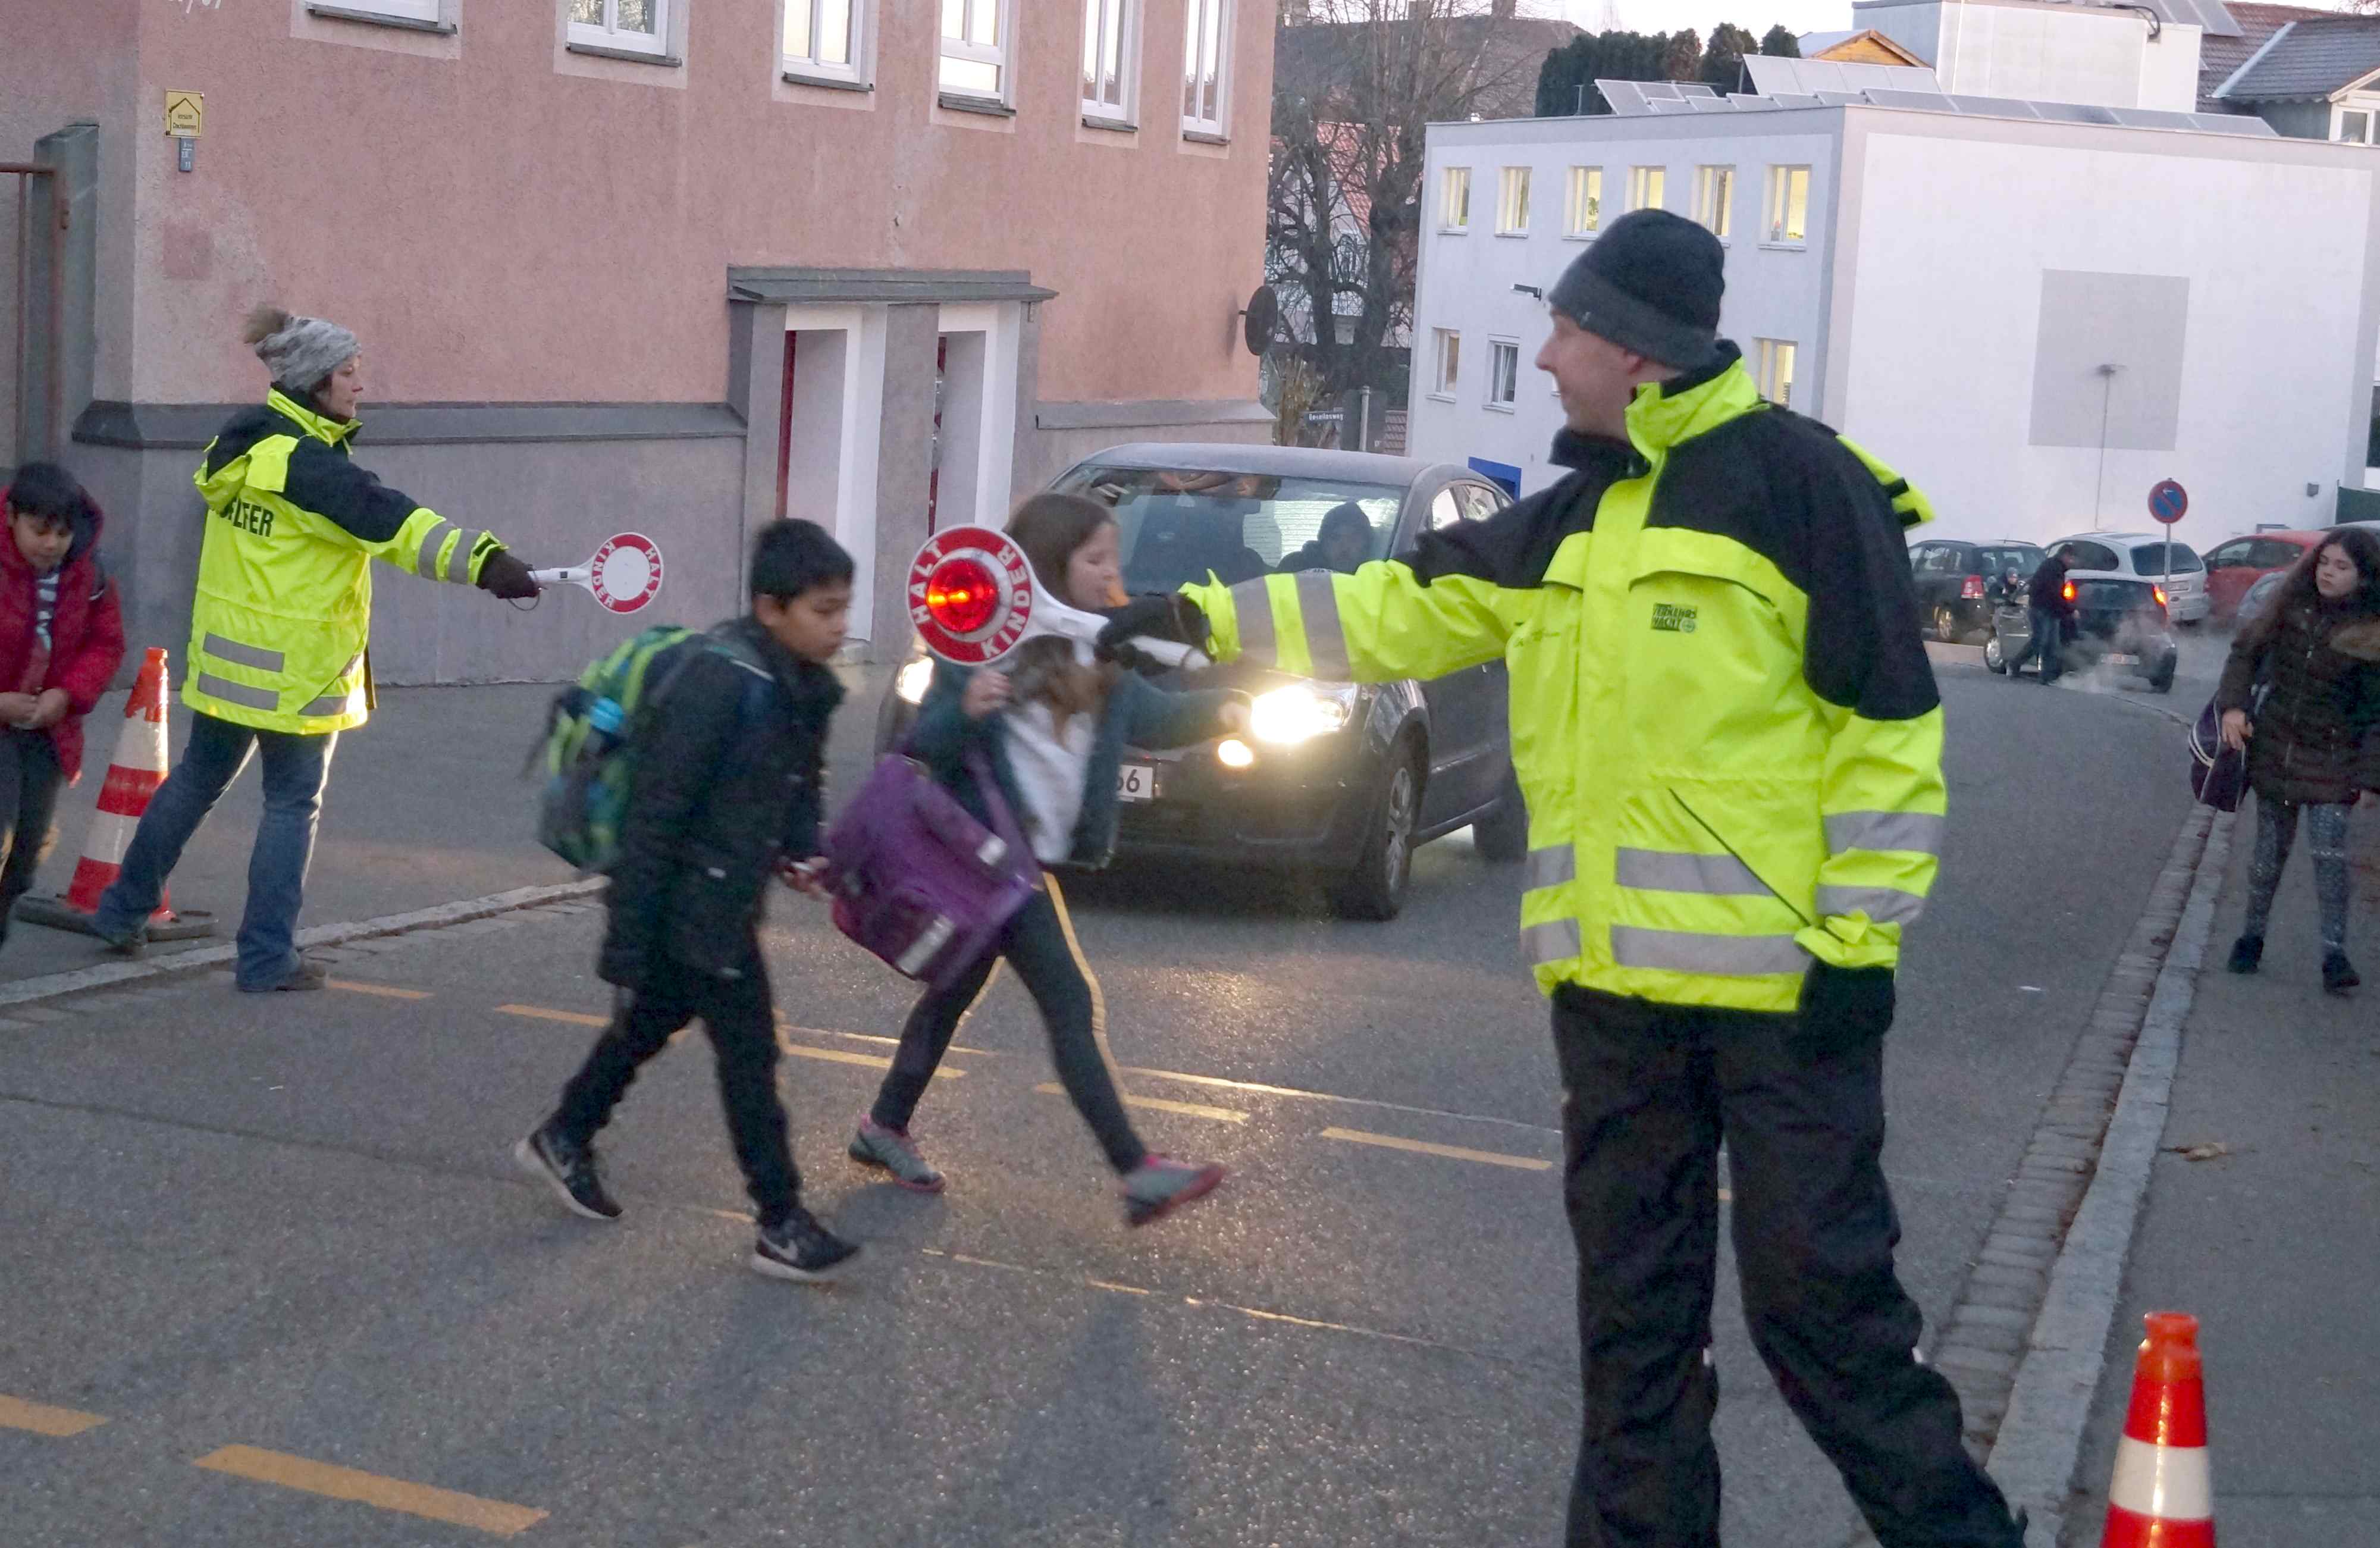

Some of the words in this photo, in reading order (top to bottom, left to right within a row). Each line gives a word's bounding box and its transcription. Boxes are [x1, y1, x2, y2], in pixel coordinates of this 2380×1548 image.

[592, 541, 616, 608] KINDER
[645, 547, 660, 598] HALT
[909, 540, 943, 624] HALT
[981, 544, 1031, 659] KINDER
